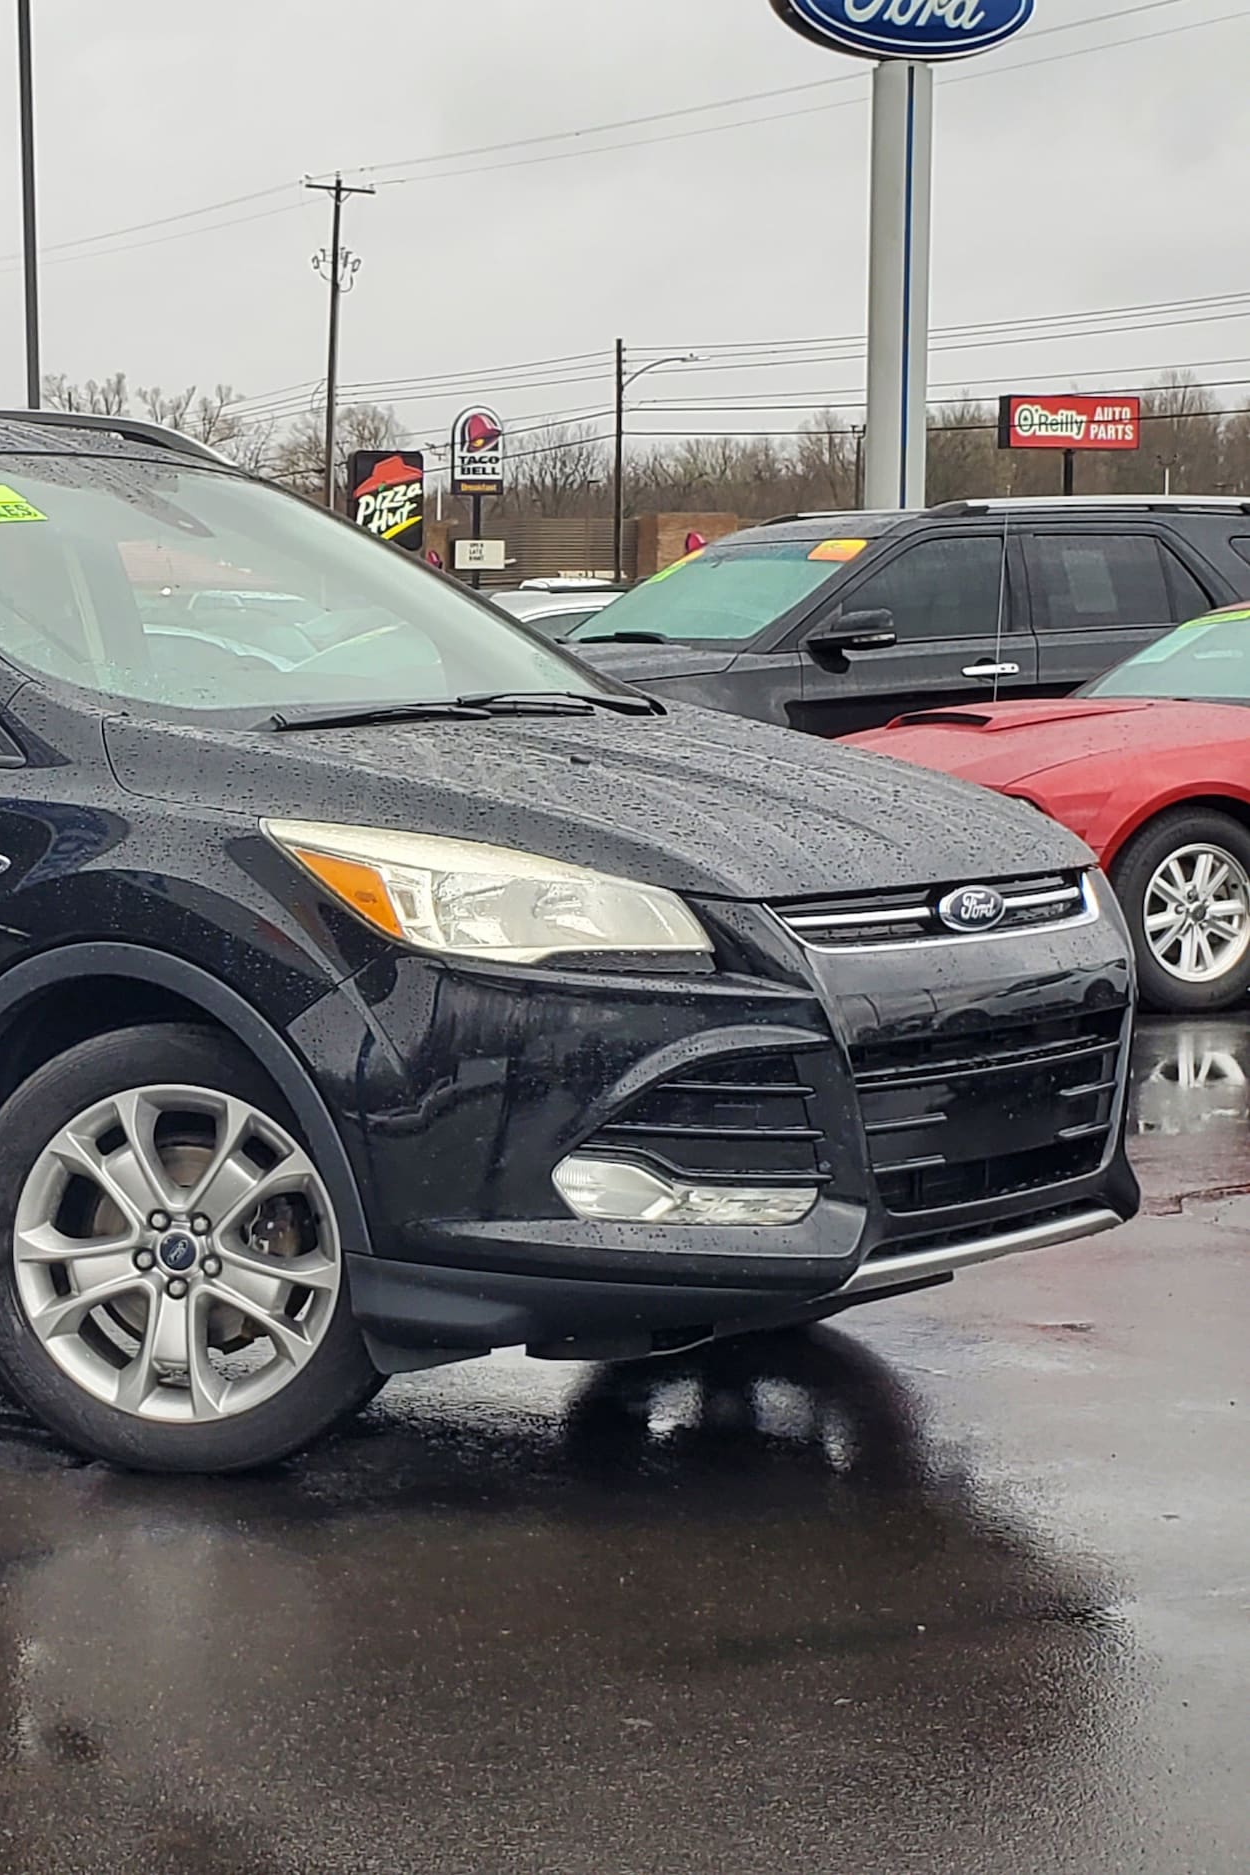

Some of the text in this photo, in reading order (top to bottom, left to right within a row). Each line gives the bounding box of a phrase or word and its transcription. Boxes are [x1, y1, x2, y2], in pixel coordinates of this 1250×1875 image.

[1017, 407, 1084, 437] O'Reilly
[1094, 406, 1131, 423] AUTO
[1090, 423, 1134, 440] PARTS
[458, 456, 500, 465] TACO
[461, 467, 500, 475] BELL
[356, 483, 422, 526] Pizza
[368, 501, 418, 533] Hut
[961, 892, 996, 919] Ford
